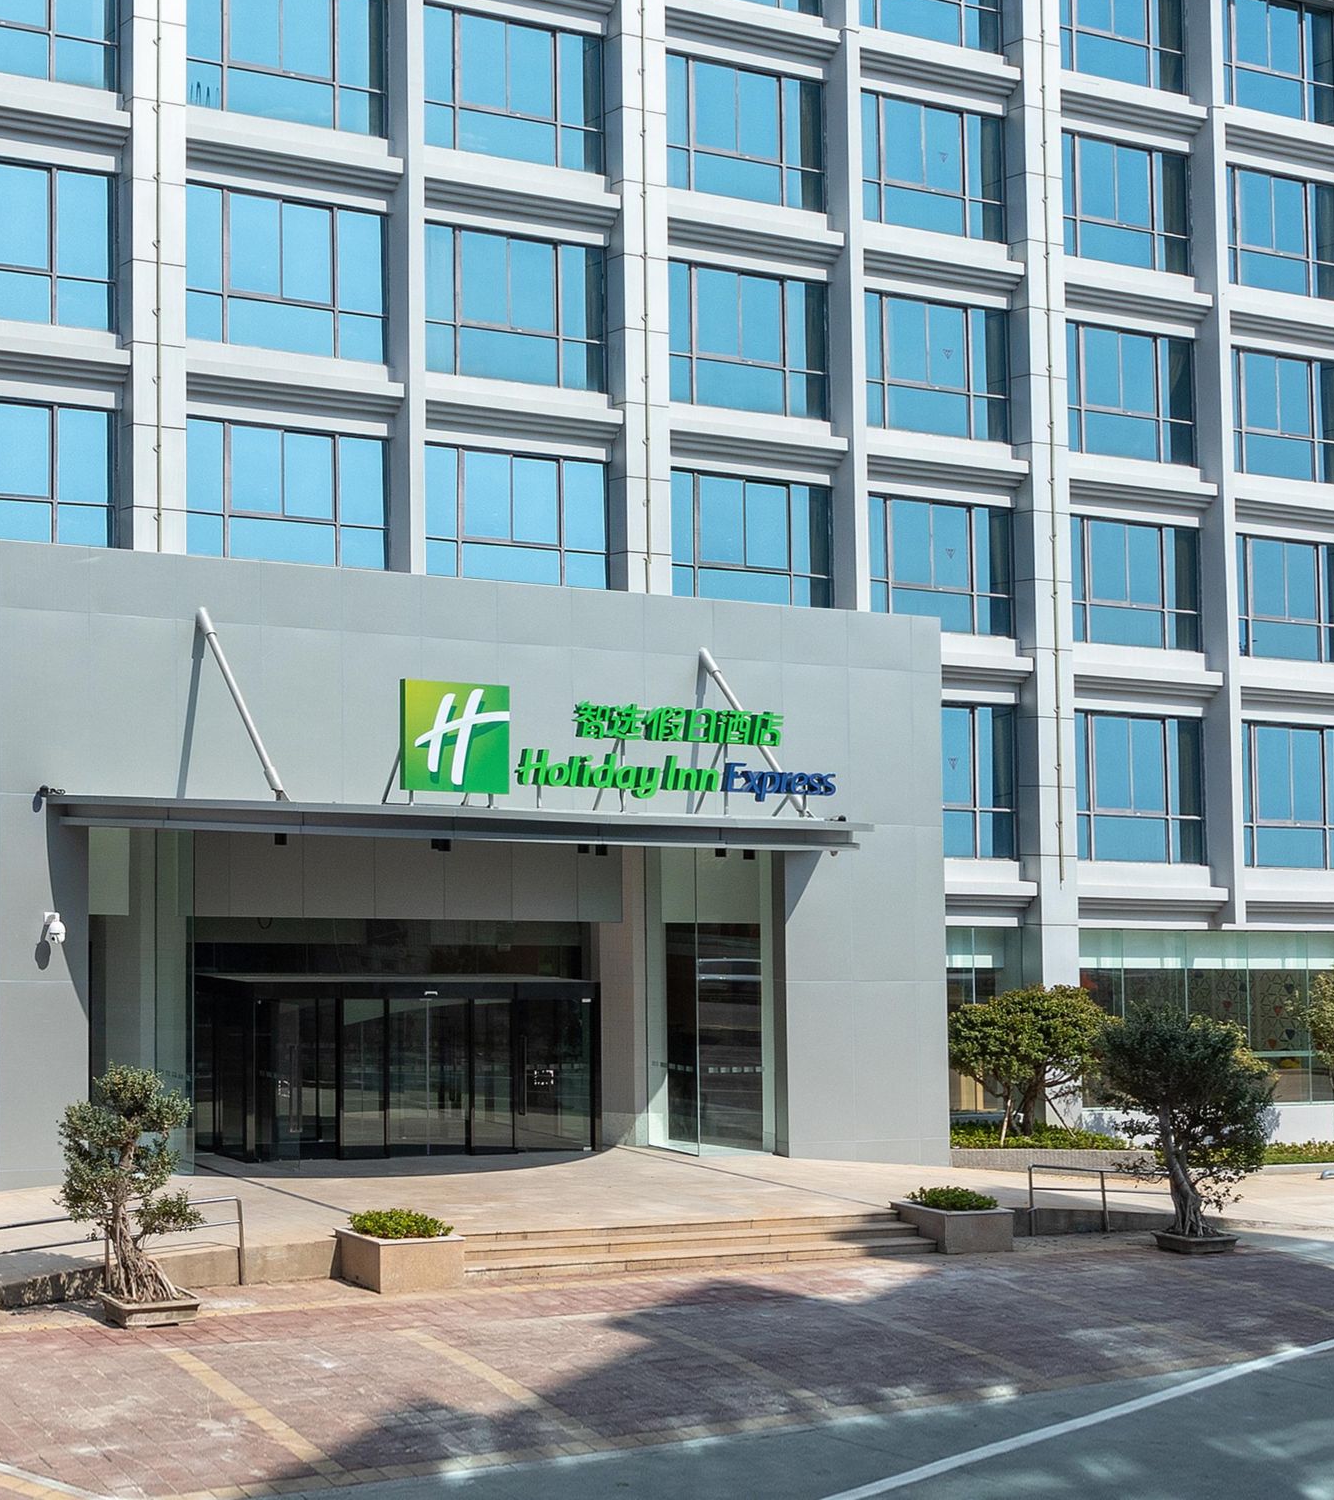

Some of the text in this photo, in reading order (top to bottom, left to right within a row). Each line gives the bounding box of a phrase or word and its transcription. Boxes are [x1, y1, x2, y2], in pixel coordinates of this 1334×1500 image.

[572, 700, 785, 746] 智选假日酒店
[515, 748, 837, 802] Holiday Inn Express
